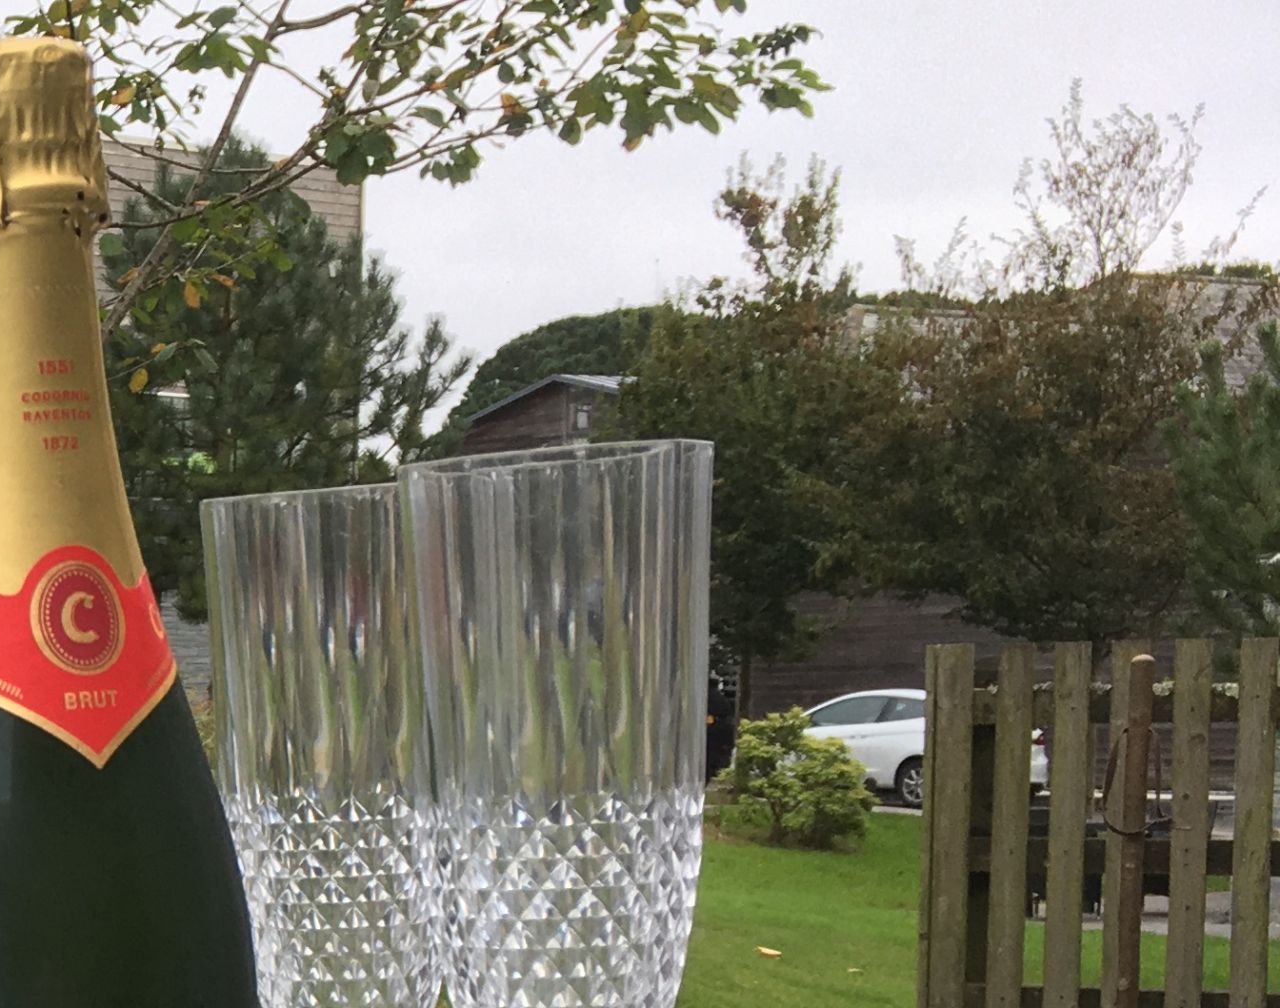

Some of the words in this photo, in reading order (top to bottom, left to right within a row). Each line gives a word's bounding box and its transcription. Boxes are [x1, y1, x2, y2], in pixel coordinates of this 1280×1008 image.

[43, 436, 79, 450] 1872
[61, 591, 100, 644] C
[64, 690, 118, 711] BRUT
